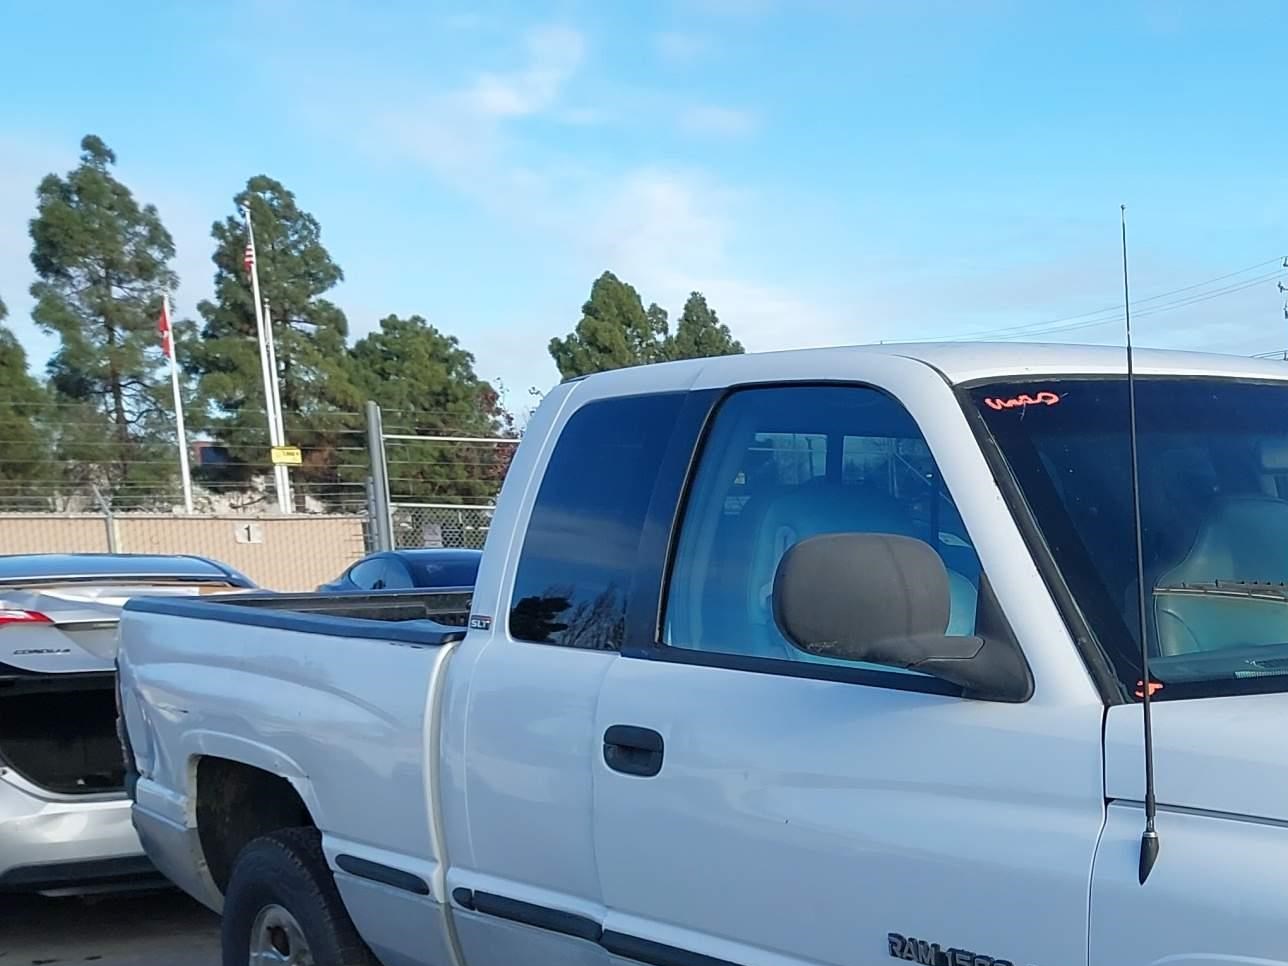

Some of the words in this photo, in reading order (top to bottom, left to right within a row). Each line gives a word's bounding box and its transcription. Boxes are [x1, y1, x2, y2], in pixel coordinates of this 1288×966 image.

[244, 524, 251, 542] 1
[471, 619, 491, 629] SLT
[888, 933, 943, 966] RAM
